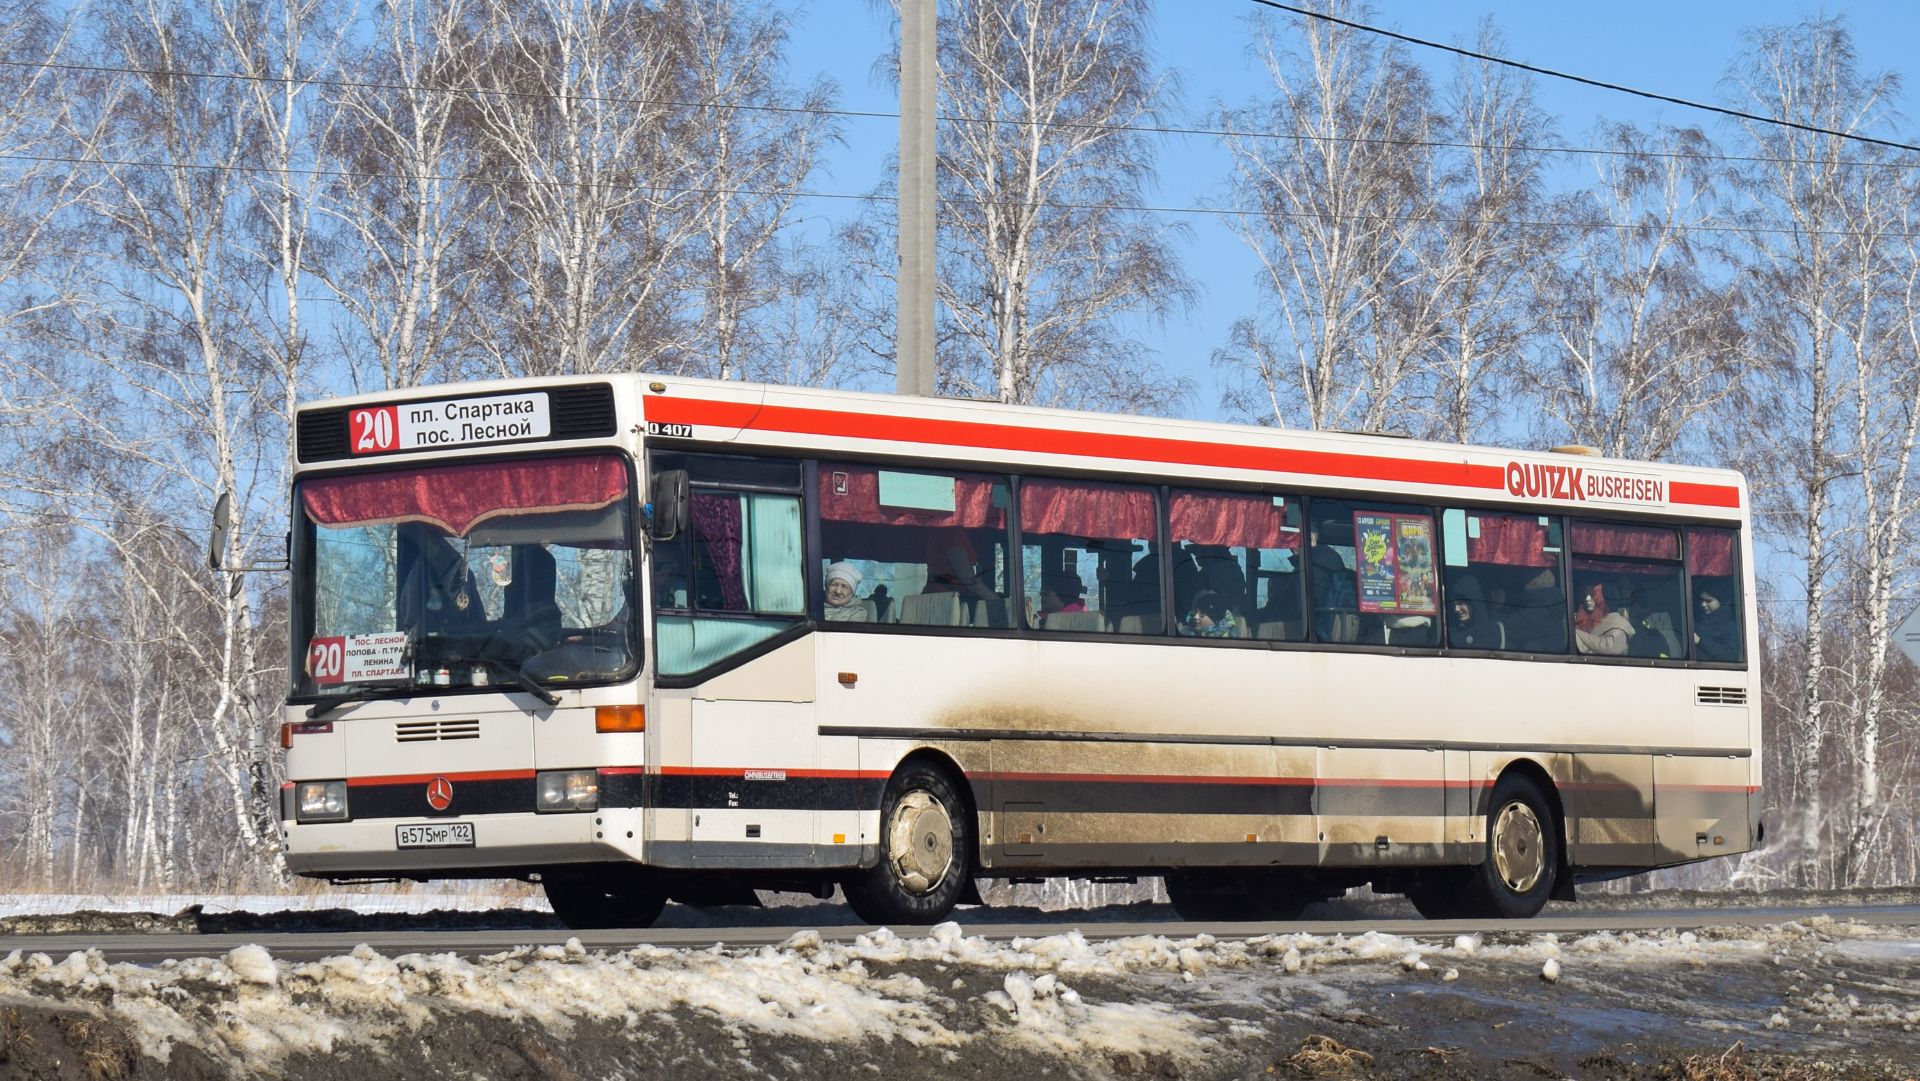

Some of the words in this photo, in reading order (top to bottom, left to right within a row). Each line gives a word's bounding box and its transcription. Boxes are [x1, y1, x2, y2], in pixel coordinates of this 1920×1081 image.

[410, 406, 439, 424] пл.
[444, 398, 535, 421] Спартака
[355, 408, 394, 450] 20
[416, 427, 456, 445] пос.
[460, 418, 532, 441] Лесной
[662, 424, 691, 436] 407
[1506, 461, 1586, 500] QUITZK
[1587, 475, 1663, 501] BUSREISEN
[355, 638, 373, 646] ПОС.
[315, 643, 341, 677] 20
[363, 658, 394, 666] ЛЕНИНА
[366, 668, 405, 676] СПАРТАКА
[402, 828, 448, 843] В575МР
[451, 826, 469, 837] 122
